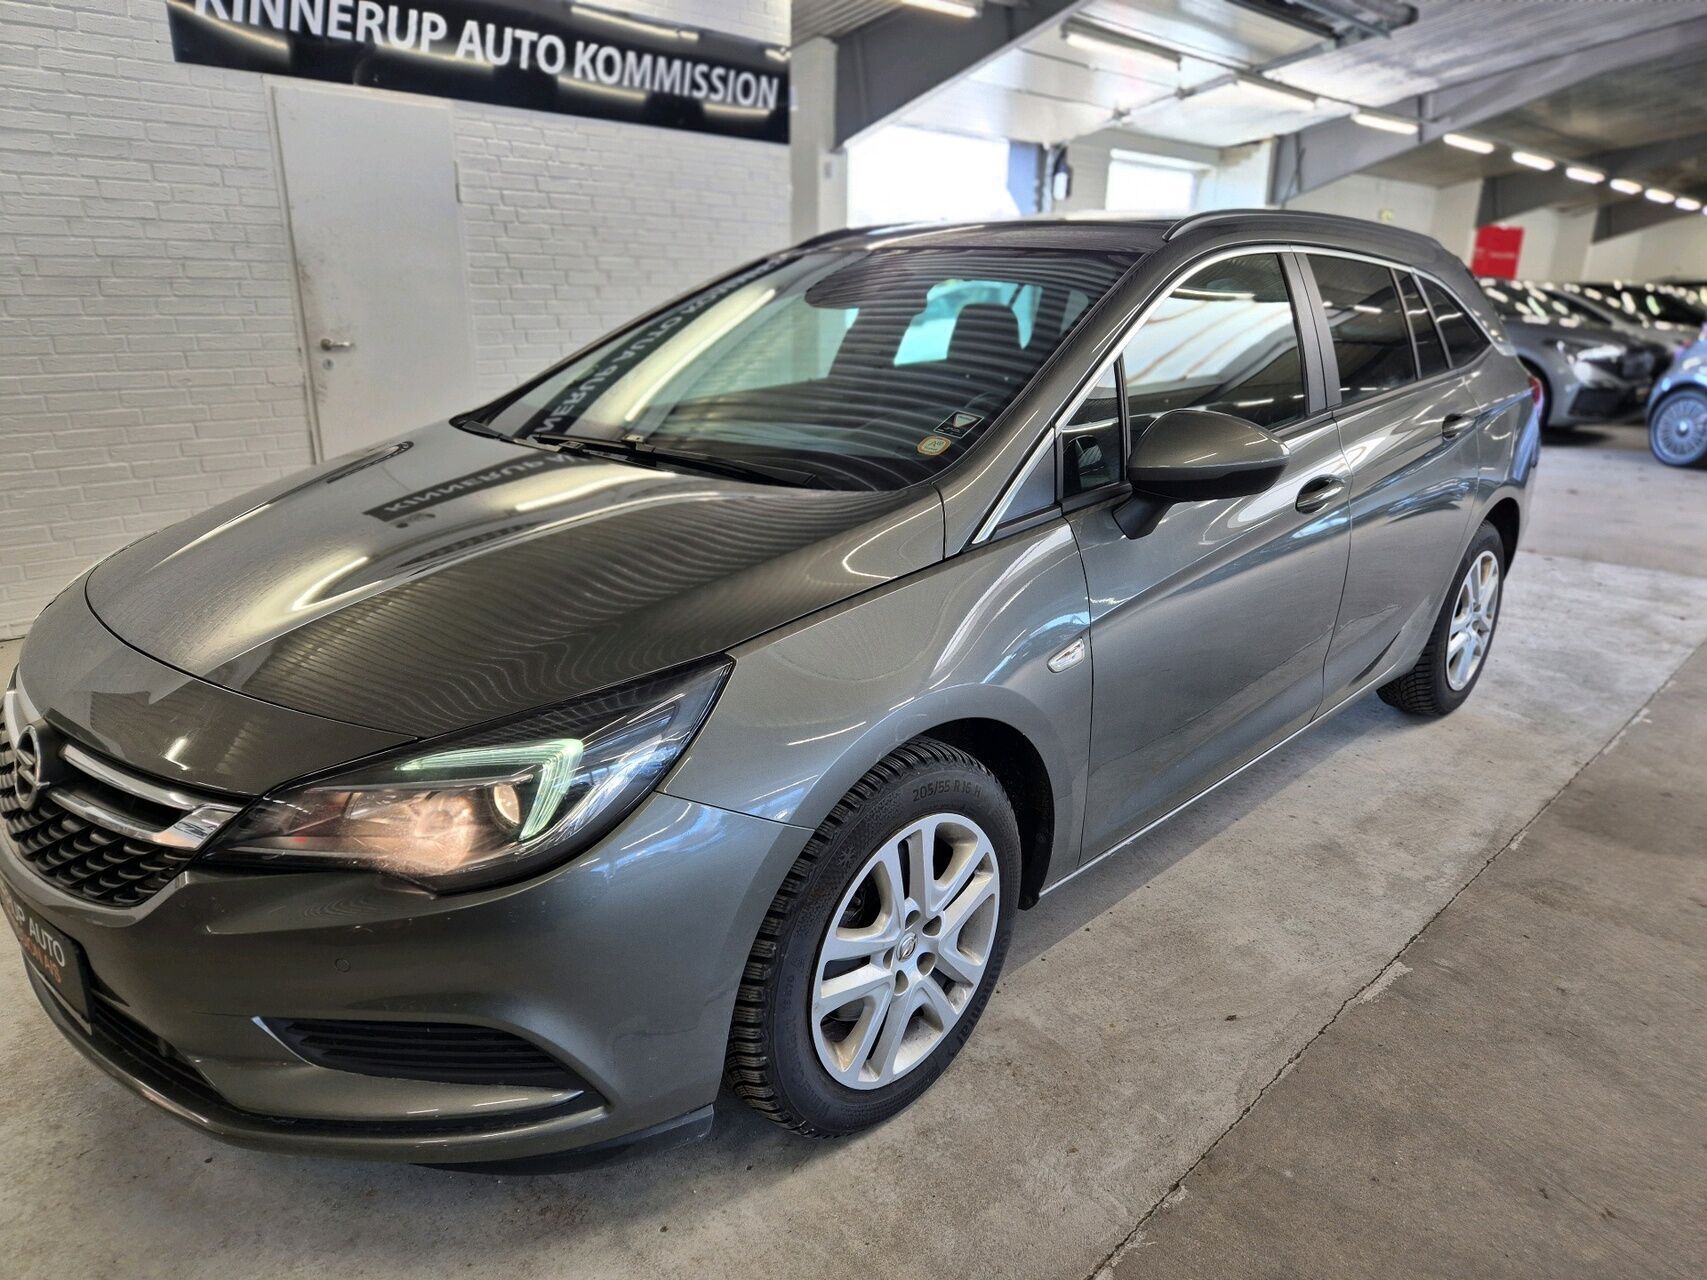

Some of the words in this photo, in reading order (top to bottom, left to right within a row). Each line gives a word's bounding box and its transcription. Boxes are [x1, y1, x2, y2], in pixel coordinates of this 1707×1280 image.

[455, 19, 566, 75] AUTO
[573, 40, 779, 110] KOMMISSION
[912, 780, 950, 802] 205/55
[953, 780, 961, 793] R
[29, 917, 65, 967] AUTO
